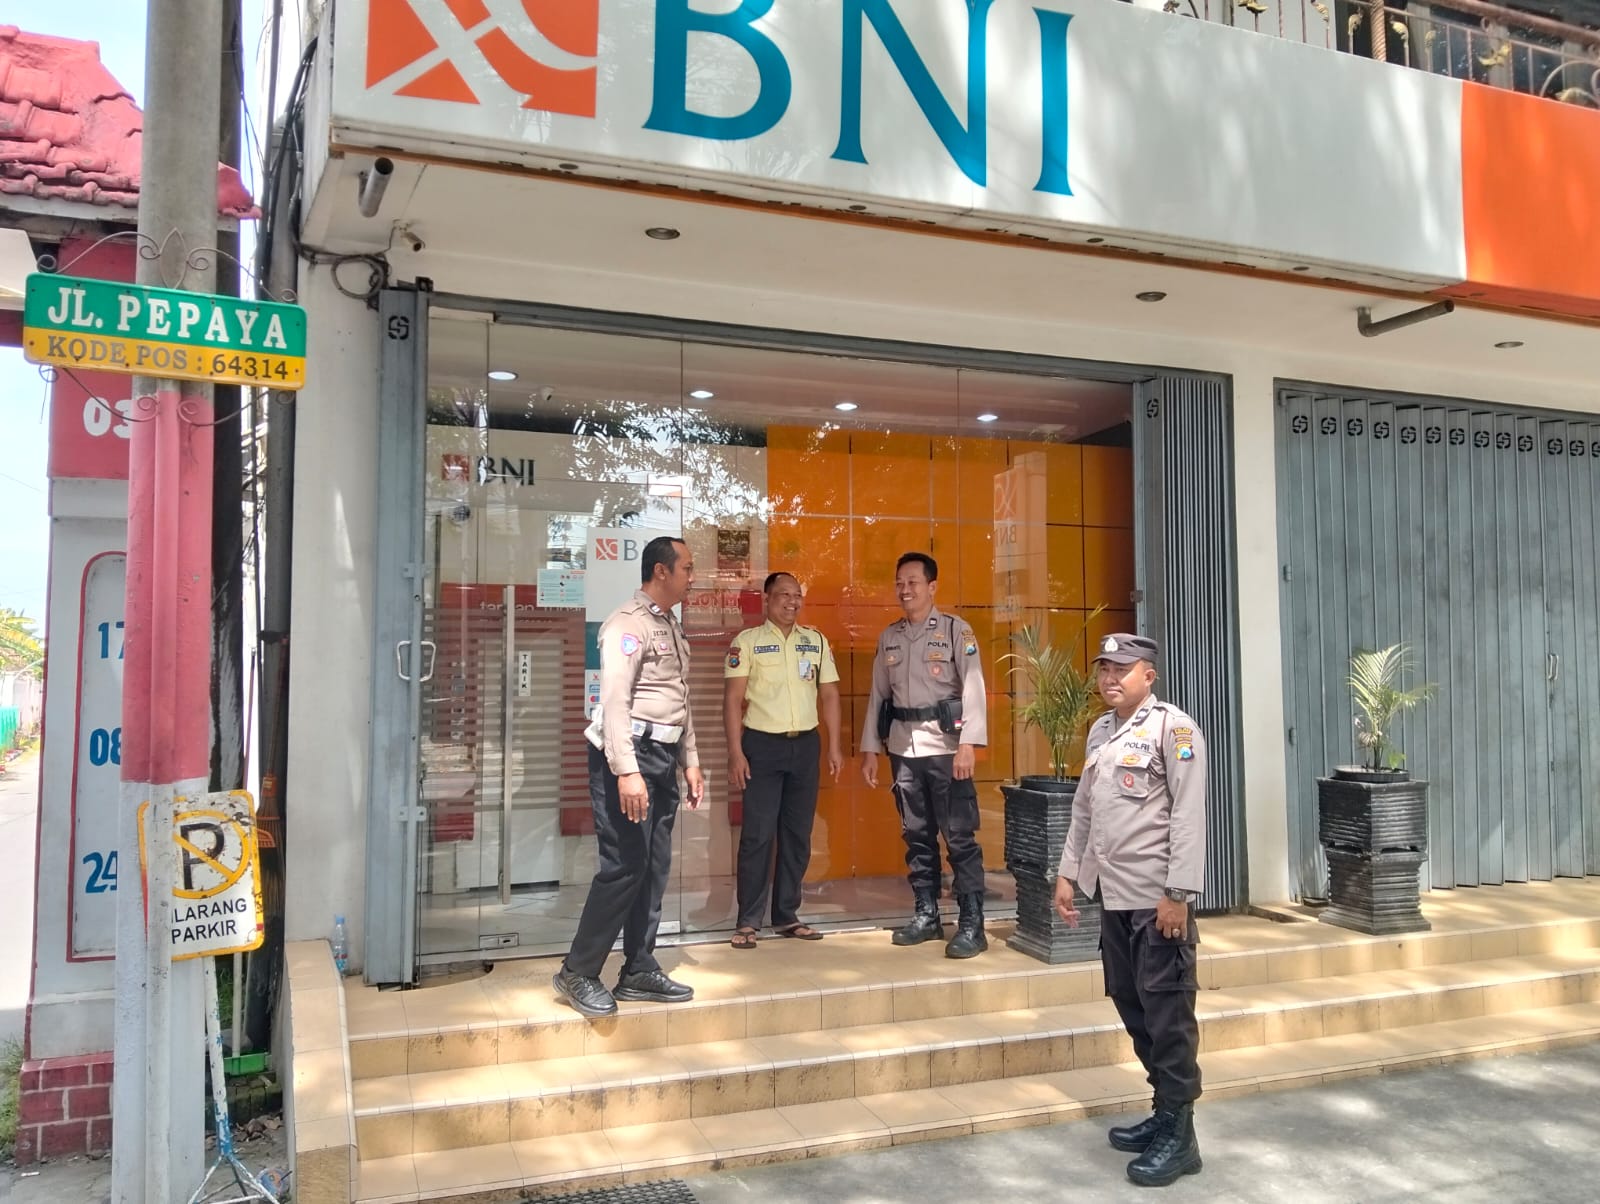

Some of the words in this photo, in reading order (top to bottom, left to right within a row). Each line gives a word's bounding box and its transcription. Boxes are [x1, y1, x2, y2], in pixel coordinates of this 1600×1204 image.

[641, 0, 1075, 196] BNI
[47, 286, 104, 331] JL.
[117, 294, 288, 349] PEPAYA
[47, 335, 126, 364] KODE
[136, 345, 188, 370] POS
[212, 354, 289, 380] 64314
[476, 456, 536, 486] BNI
[1123, 741, 1151, 752] POLRI
[171, 919, 238, 945] PARKIR
